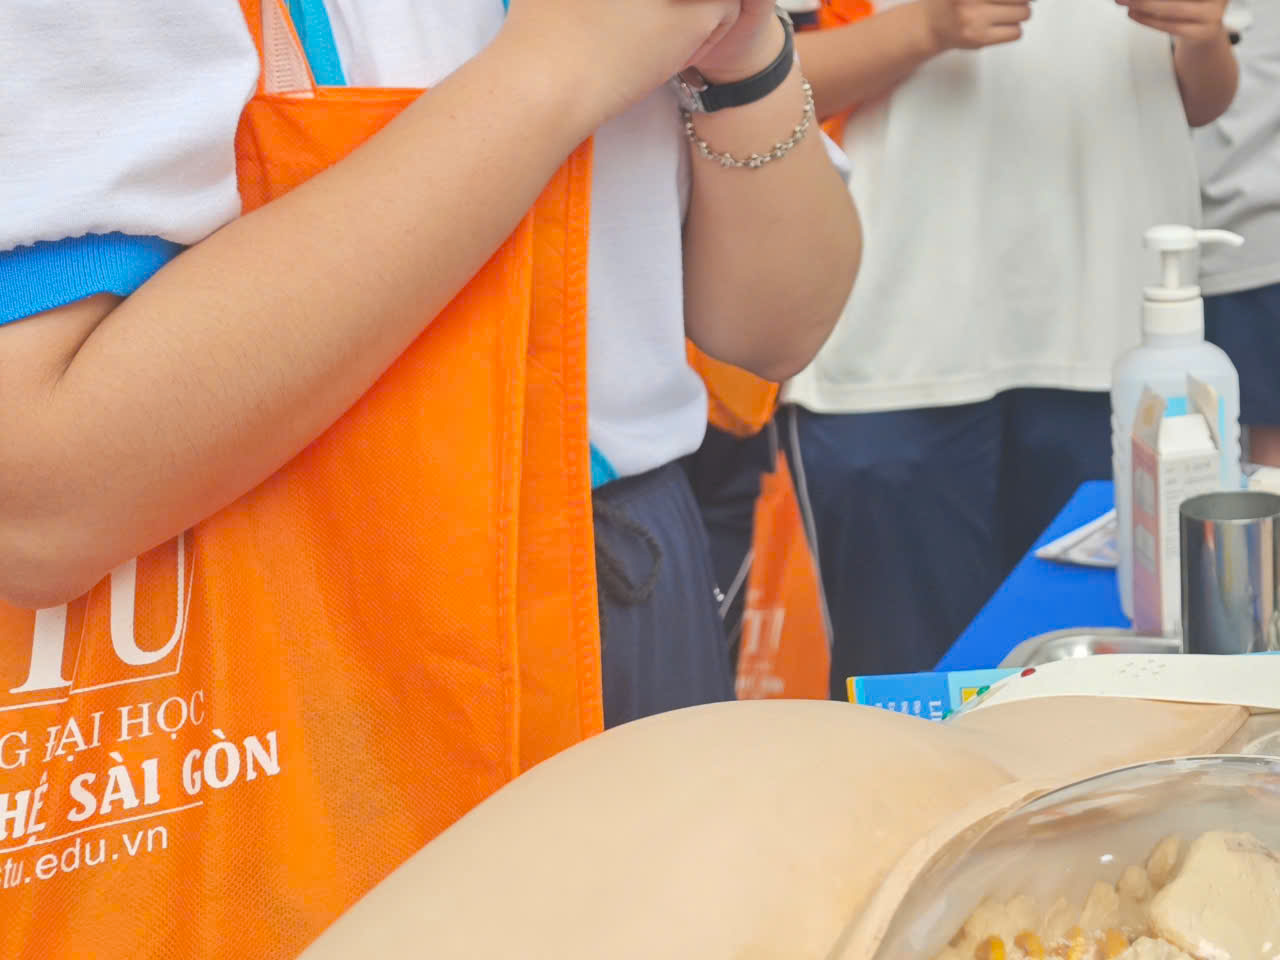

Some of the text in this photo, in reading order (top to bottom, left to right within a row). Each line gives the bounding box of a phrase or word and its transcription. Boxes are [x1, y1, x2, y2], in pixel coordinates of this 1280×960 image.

[117, 690, 205, 742] HỌC
[67, 751, 160, 824] SÀI
[183, 727, 282, 797] GÒN
[0, 825, 168, 890] tu.edu.vn
